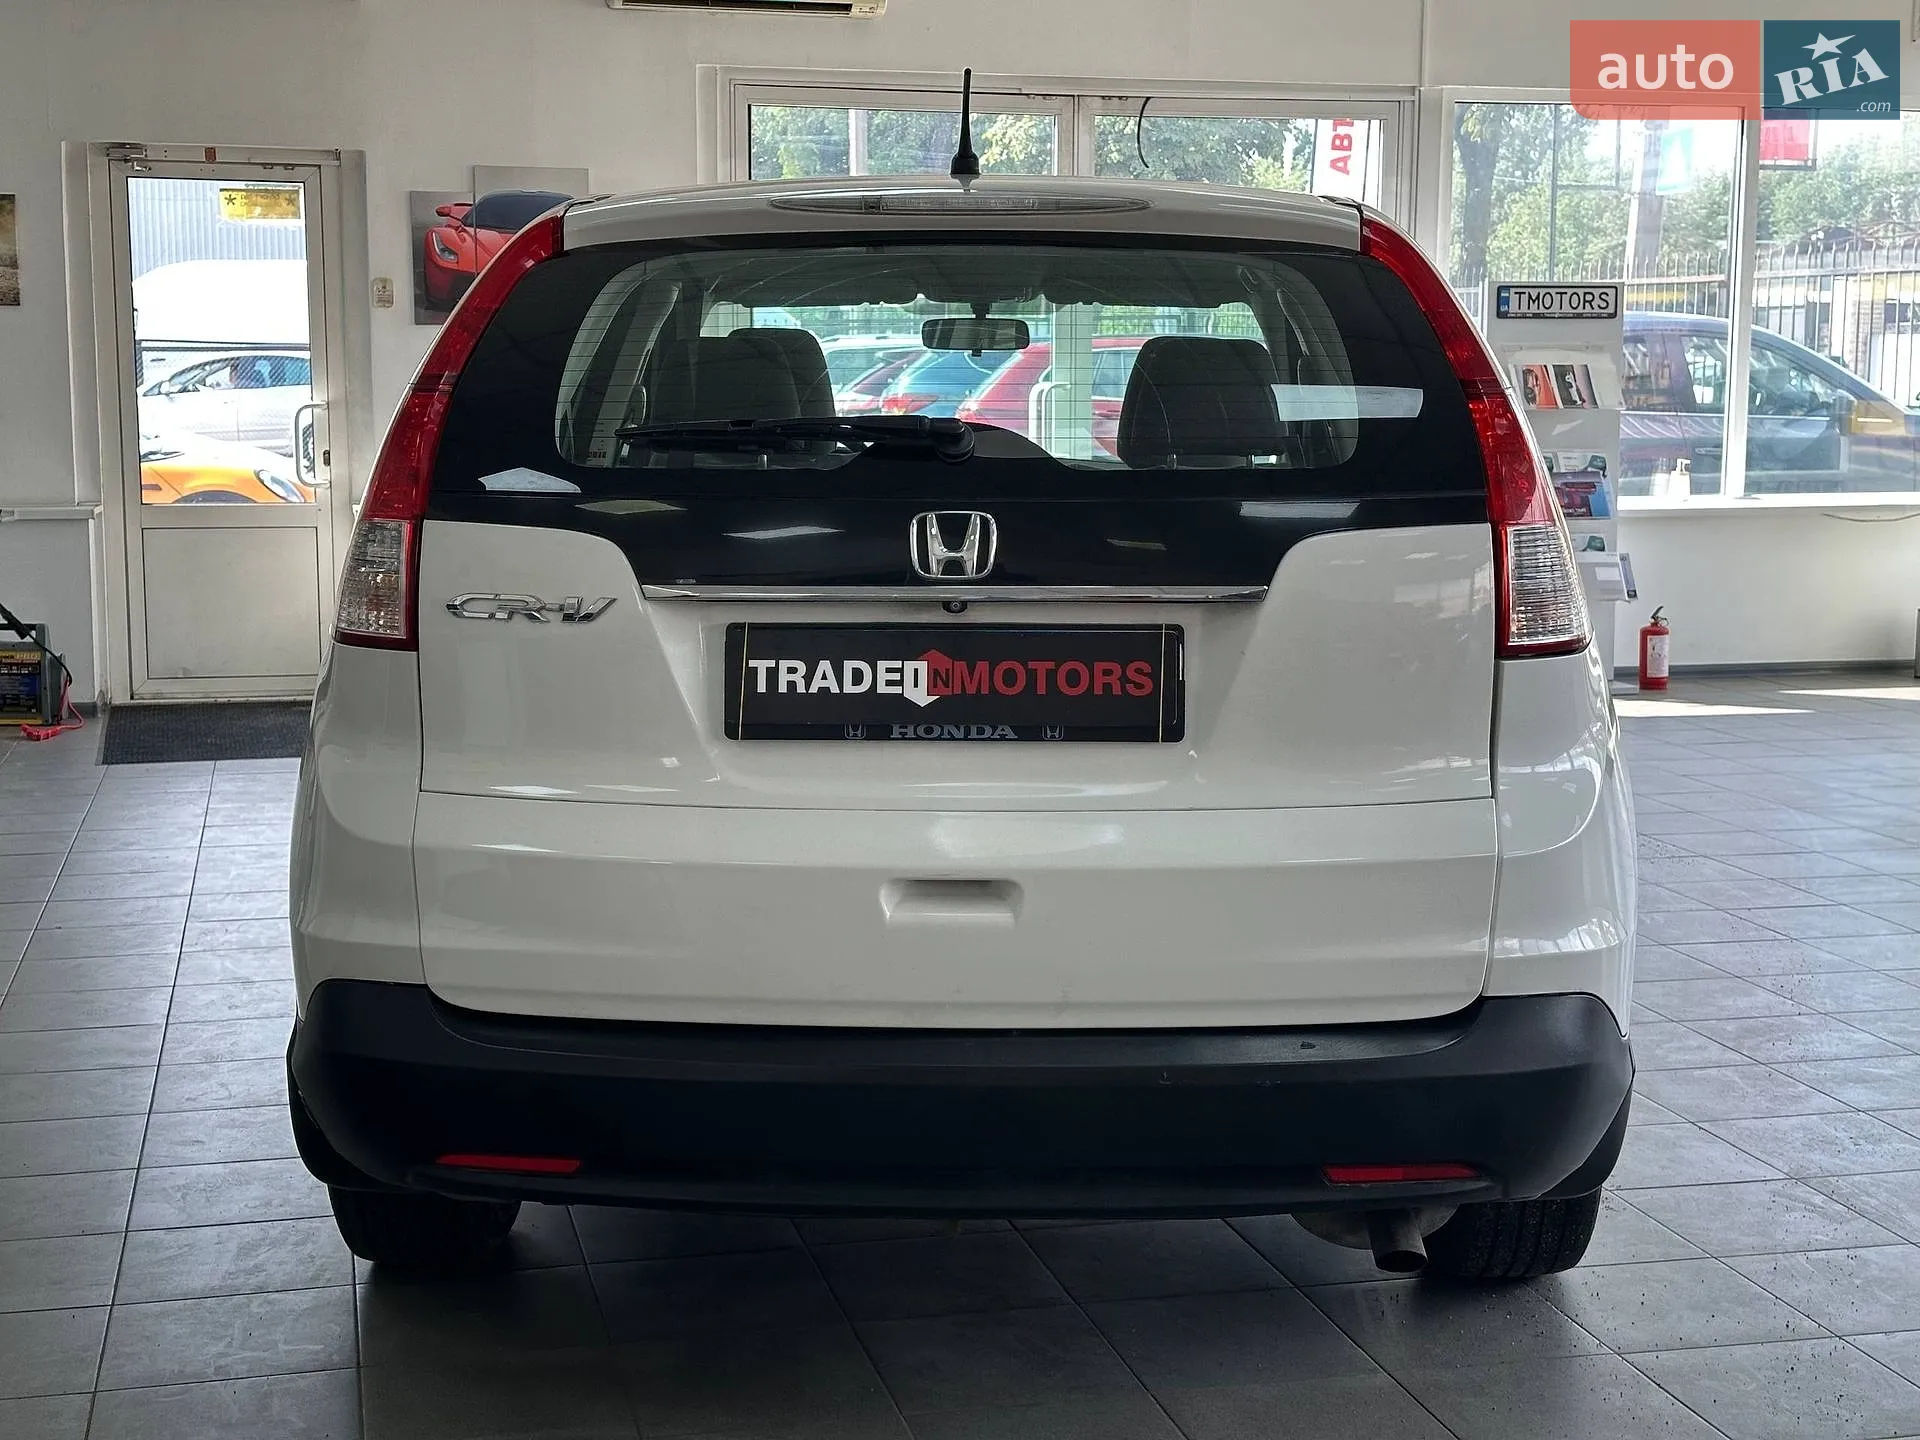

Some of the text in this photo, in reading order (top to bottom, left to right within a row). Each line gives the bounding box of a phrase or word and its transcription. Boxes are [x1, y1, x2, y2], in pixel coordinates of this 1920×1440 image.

[1514, 291, 1610, 310] TMOTORS
[446, 592, 617, 622] CR-V
[889, 724, 1018, 739] HONDA
